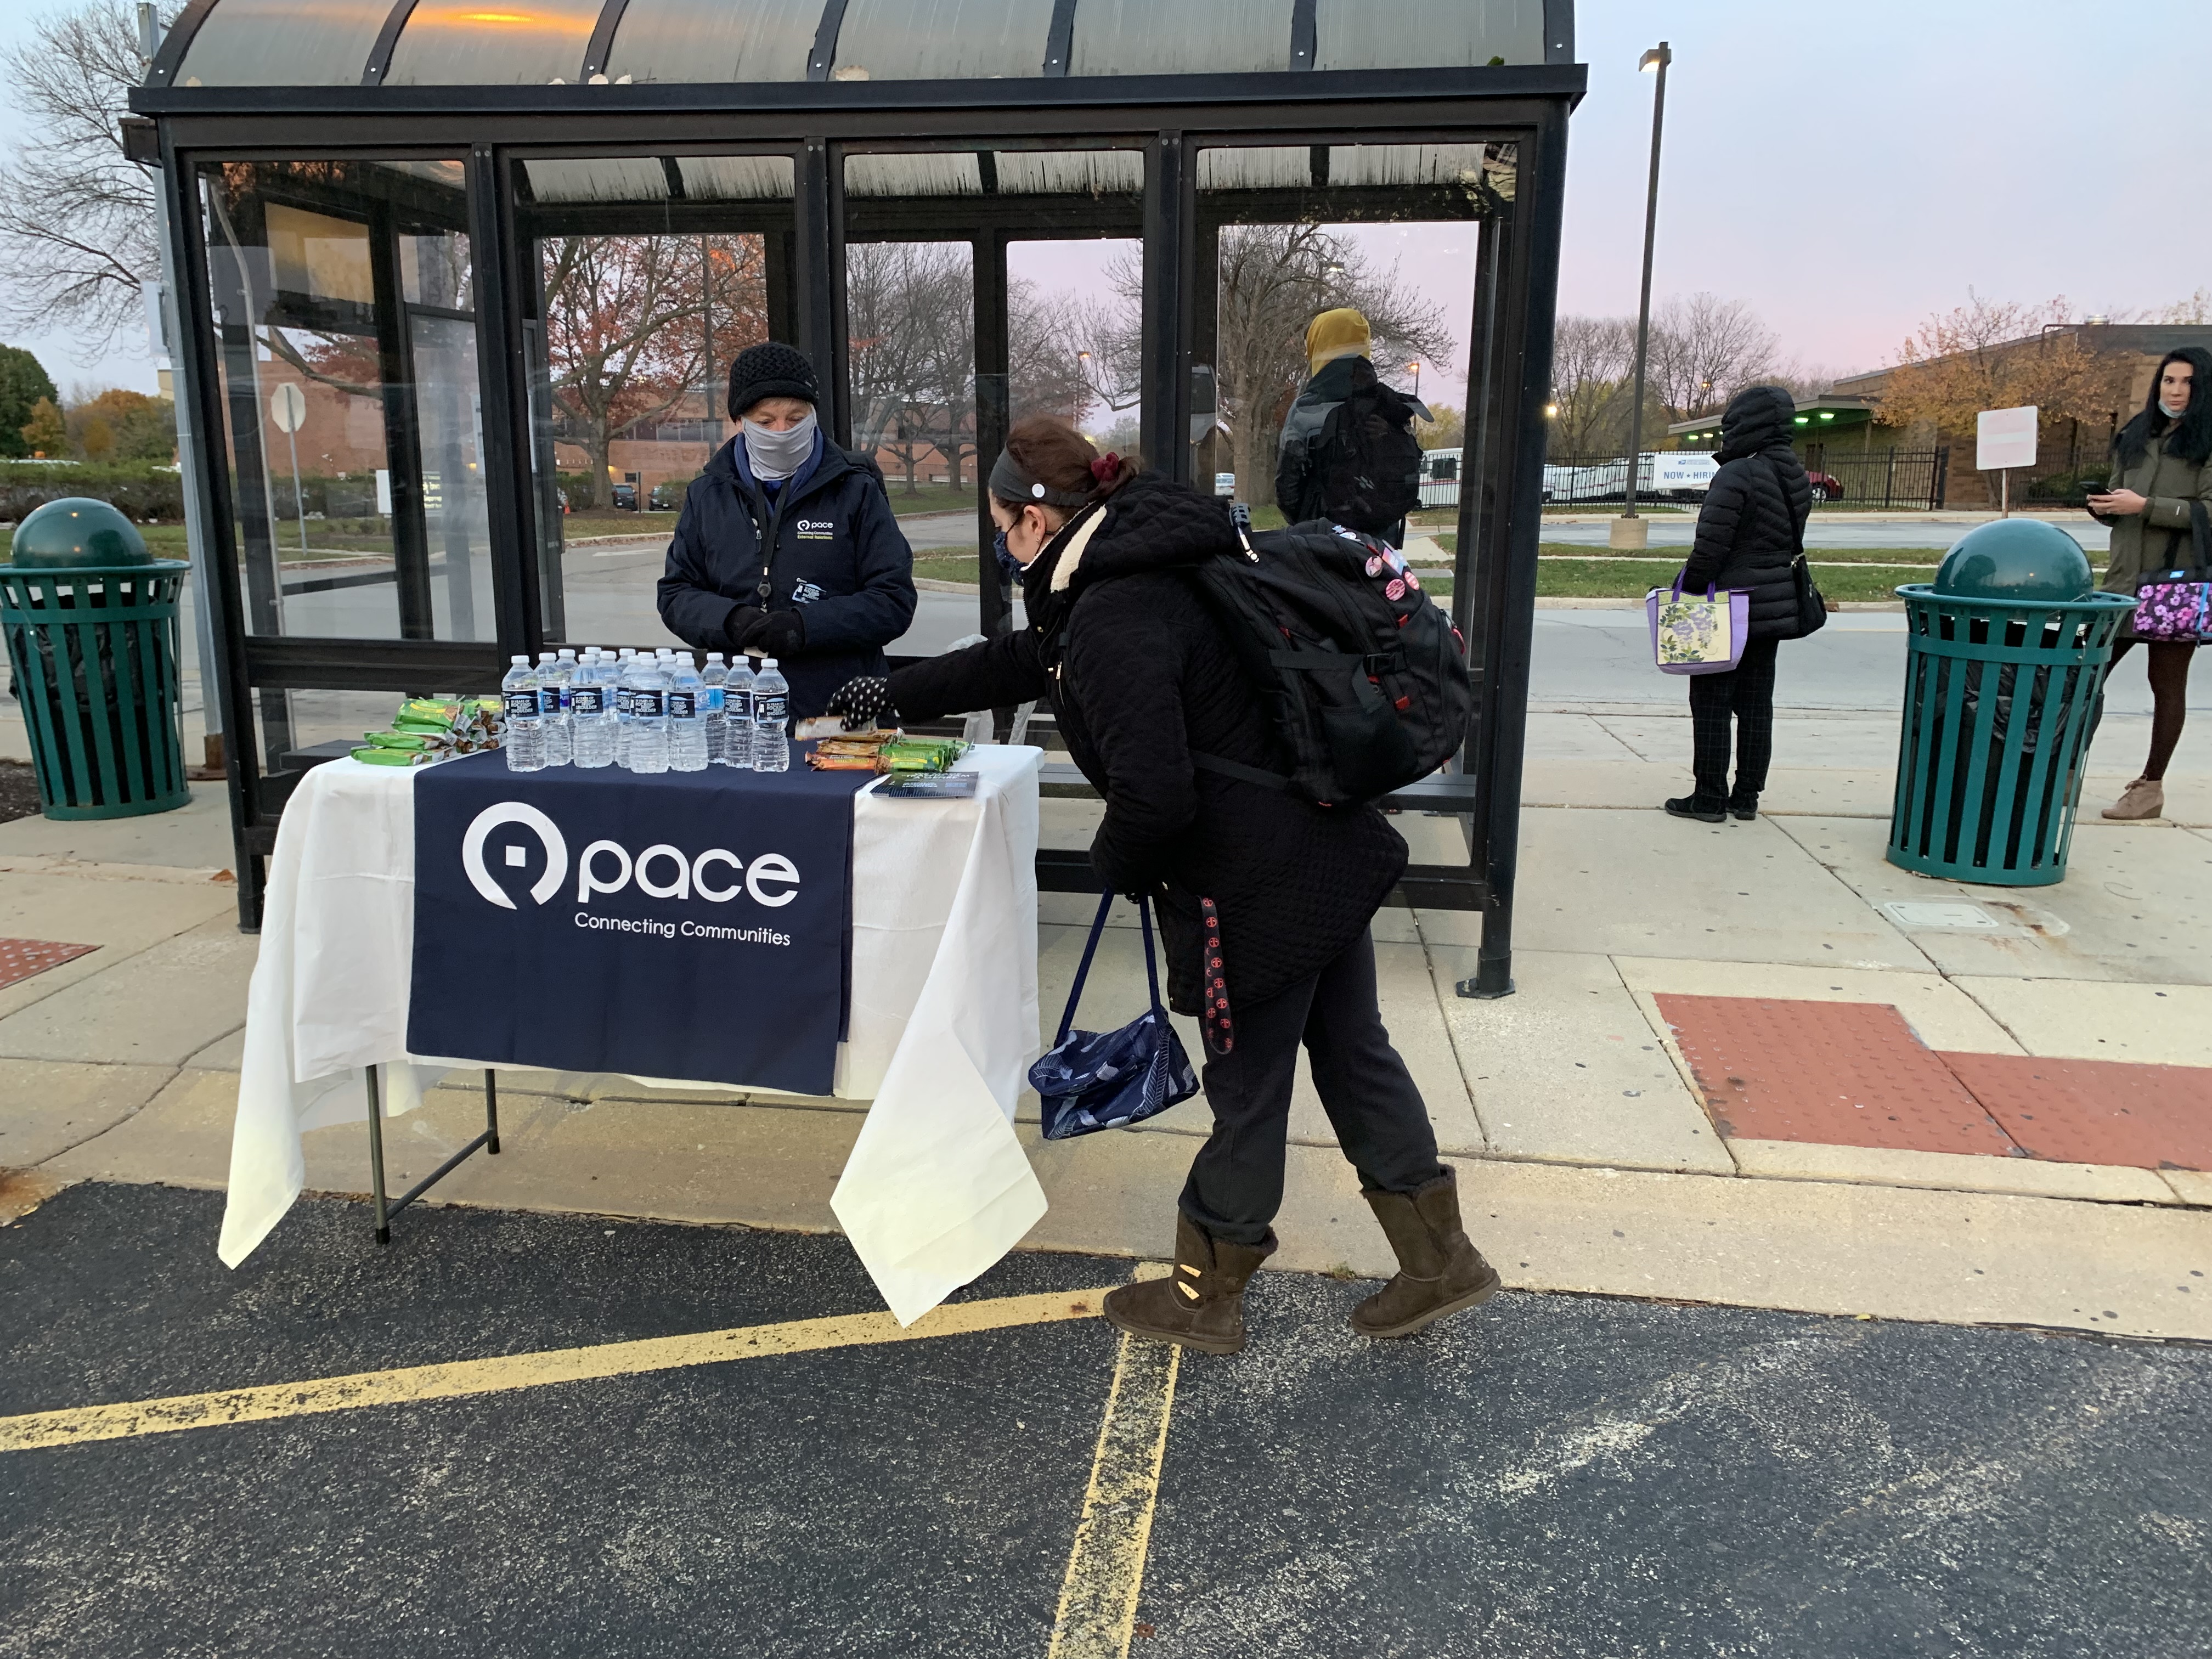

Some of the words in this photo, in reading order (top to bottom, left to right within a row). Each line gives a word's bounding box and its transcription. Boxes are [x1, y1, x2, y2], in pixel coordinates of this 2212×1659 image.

[578, 839, 800, 908] pace
[575, 912, 675, 939] Connecting
[681, 921, 791, 946] Communities
